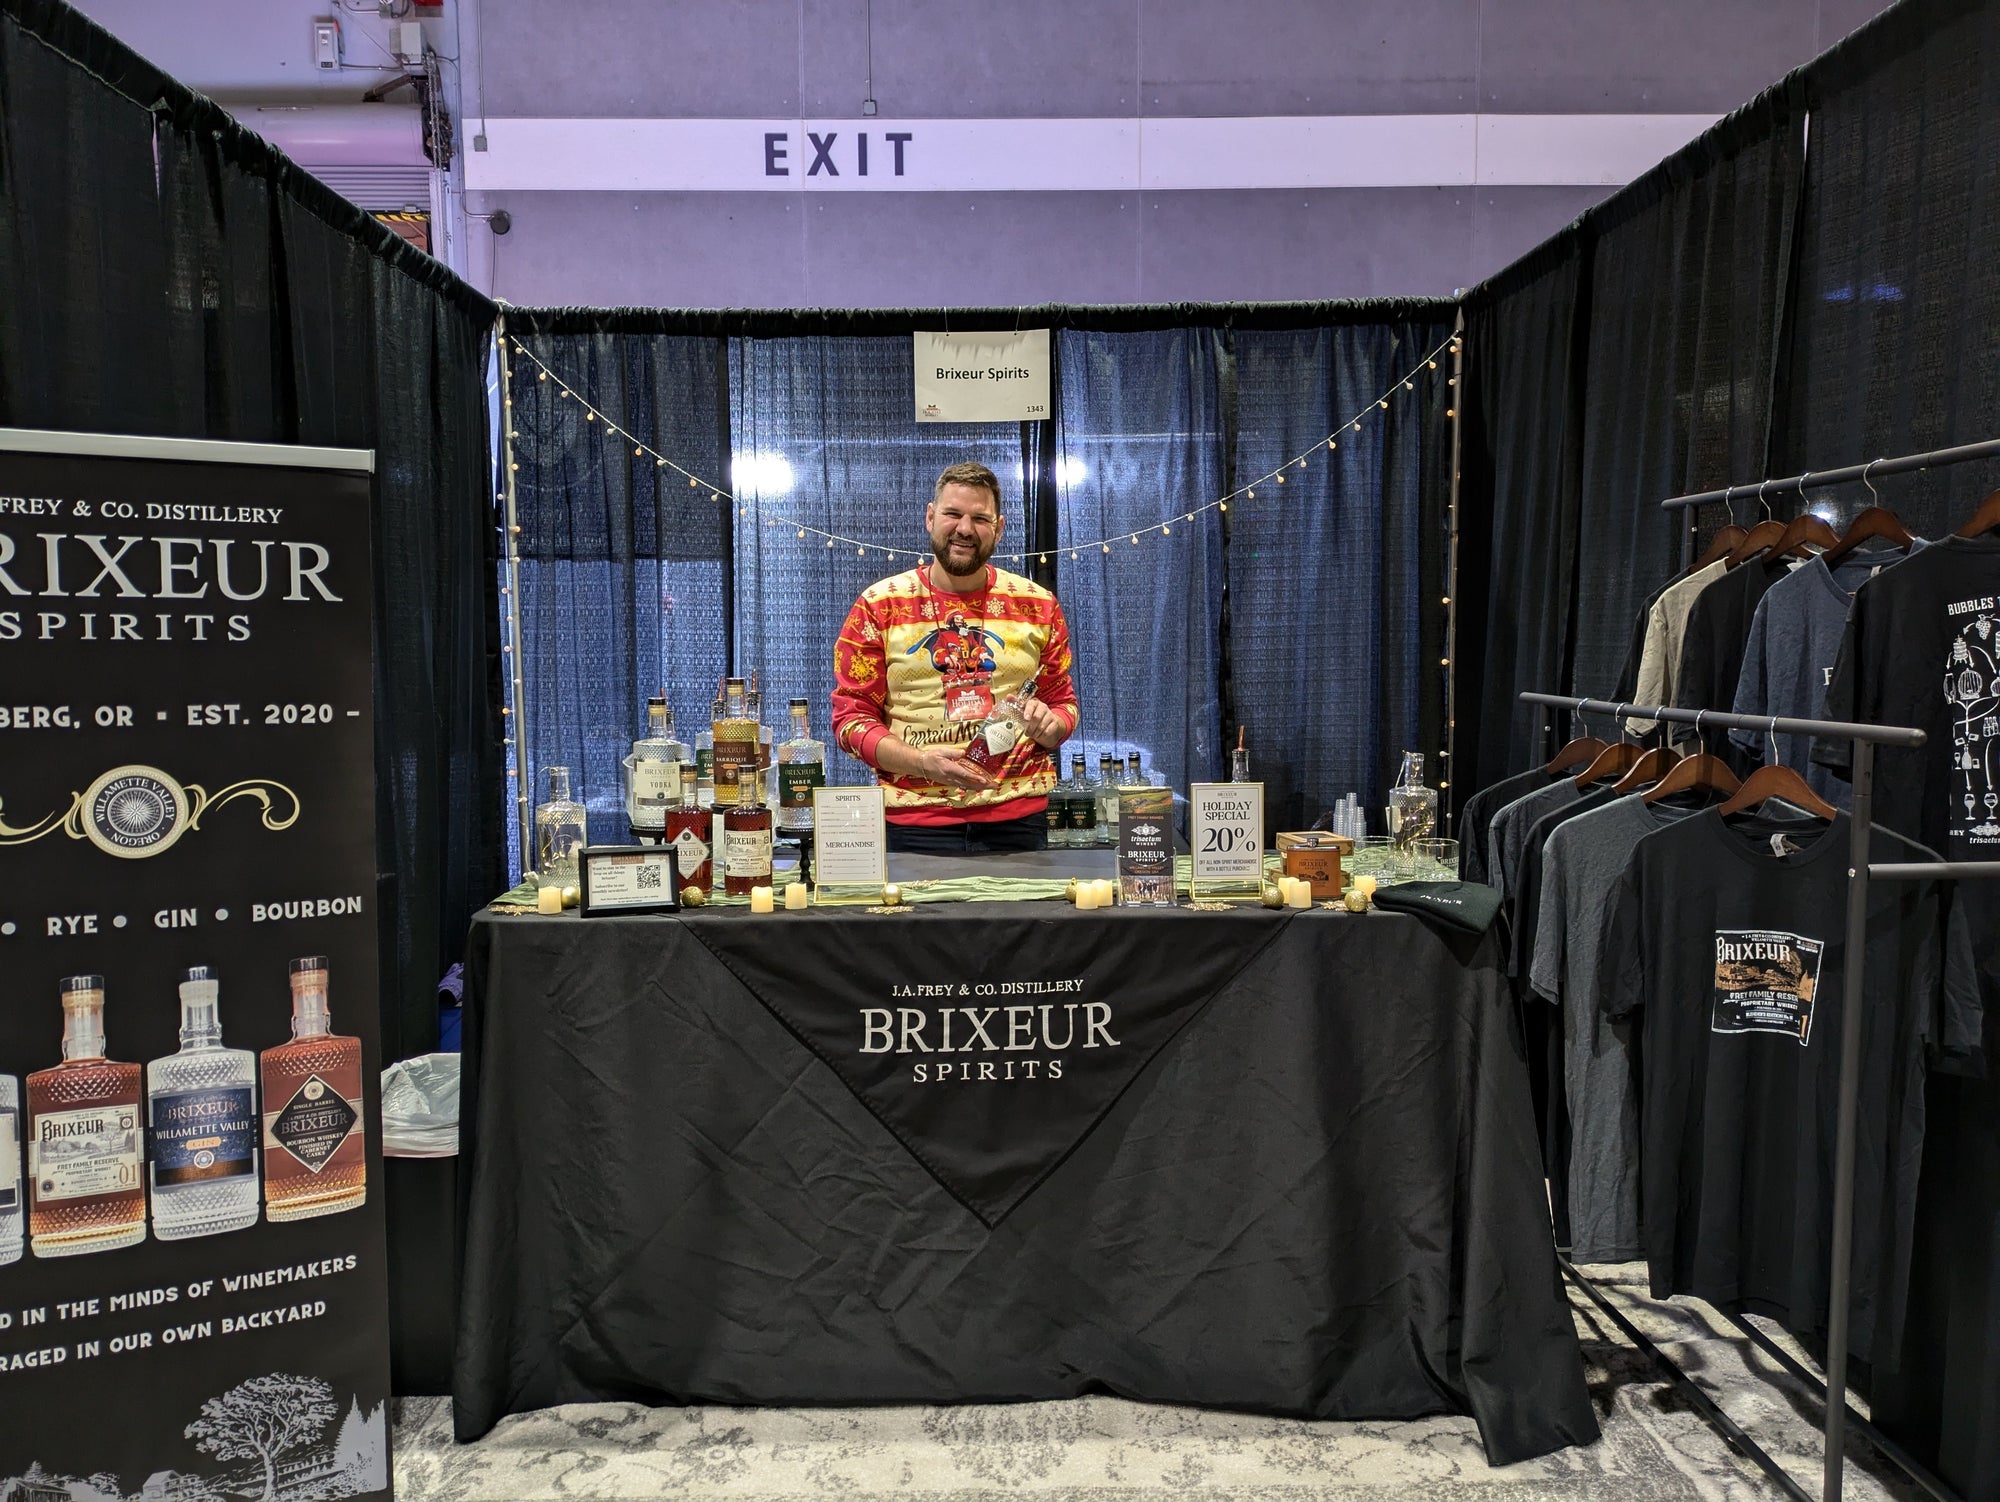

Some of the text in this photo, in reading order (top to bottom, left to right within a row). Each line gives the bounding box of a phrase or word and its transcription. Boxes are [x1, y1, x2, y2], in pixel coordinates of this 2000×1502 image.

[765, 132, 914, 176] EXIT
[936, 366, 1030, 382] Brixeur Spirits
[1026, 405, 1044, 413] 1343
[72, 500, 92, 517] &
[100, 501, 139, 519] CO.
[146, 503, 283, 525] DISTILLERY
[1947, 596, 1995, 616] BUBBLES
[0, 612, 251, 641] SPIRITS
[95, 705, 134, 727] OR
[187, 704, 250, 726] EST.
[264, 704, 333, 724] 2020
[95, 777, 175, 823] WILLAMETTE VALLEY
[835, 794, 861, 802] SPIRITS
[1202, 801, 1252, 811] HOLIDAY
[1205, 811, 1250, 821] SPECIAL
[110, 831, 160, 847] OREGON
[1200, 827, 1256, 853] 20%
[677, 849, 704, 857] RIXEUR
[1128, 850, 1165, 858] BRIXEUR
[47, 896, 362, 936] RYE GIN BOURBON
[1716, 937, 1792, 964] BRIXEUR
[958, 984, 970, 996] &
[974, 984, 998, 996] CO.
[1000, 979, 1084, 994] DISTILLERY
[1748, 990, 1775, 999] FAMILY
[858, 1001, 1121, 1054] BRIXEUR
[913, 1060, 1062, 1083] SPIRITS
[41, 1119, 104, 1142] BRIXEUR
[156, 1120, 250, 1140] WILLAMETTE VALLEY
[281, 1112, 348, 1135] BRIXEUR
[286, 1137, 316, 1147] BOURBON
[22, 1307, 46, 1326] IN
[56, 1298, 100, 1320] THE
[109, 1286, 179, 1312] MINDS
[188, 1280, 214, 1299] OF
[222, 1255, 357, 1293] WINEMAKERS
[77, 1341, 100, 1360] IN
[109, 1332, 153, 1354] OUR
[162, 1321, 212, 1343] OWN
[221, 1301, 327, 1335] BACKYARD
